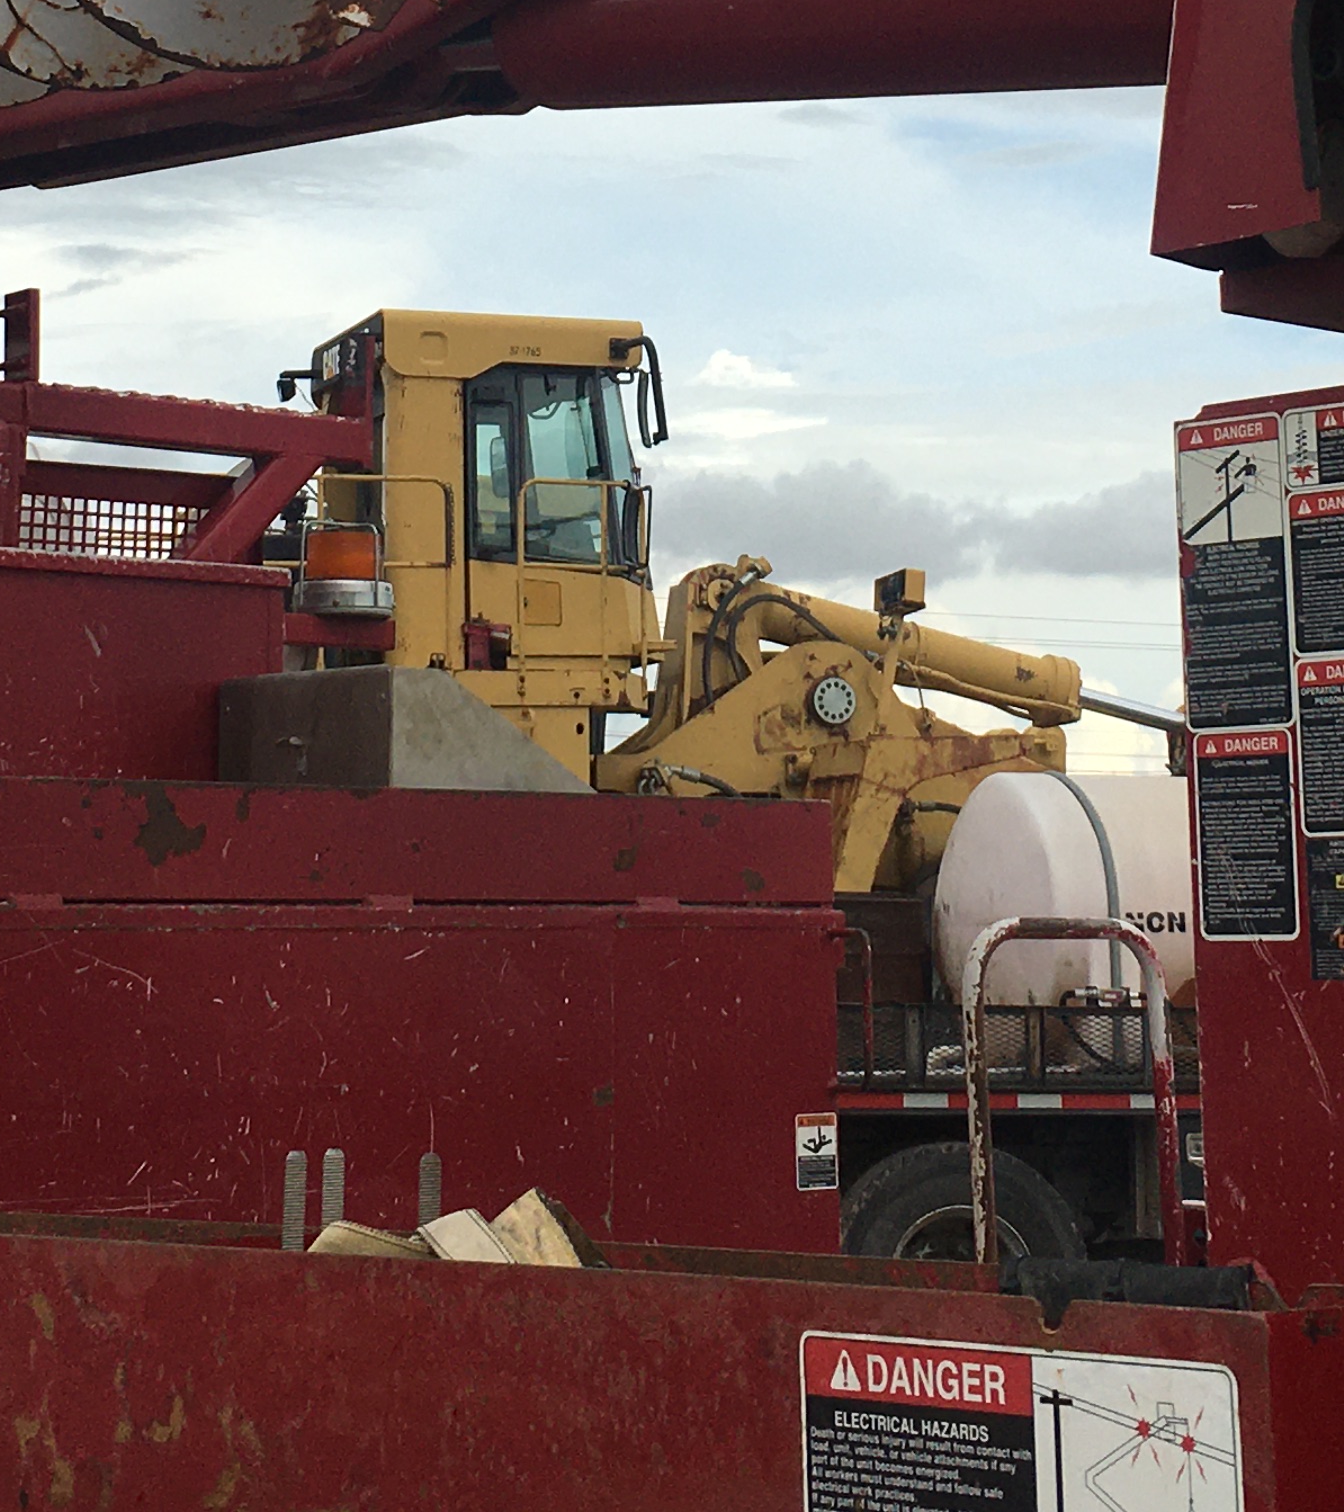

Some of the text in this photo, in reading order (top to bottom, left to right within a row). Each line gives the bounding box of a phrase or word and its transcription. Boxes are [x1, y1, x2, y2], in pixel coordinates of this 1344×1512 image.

[1213, 422, 1264, 441] DANGER
[1301, 685, 1341, 696] OPERATION
[1224, 737, 1279, 753] DANGER
[867, 1354, 1006, 1405] DANGER
[834, 1410, 990, 1443] ELECTRICAL HAZARDS
[810, 1426, 1032, 1460] Death or serious injury will result from contact with
[811, 1454, 828, 1465] part
[829, 1455, 839, 1465] of
[840, 1456, 854, 1468] the
[856, 1460, 873, 1470] unit
[874, 1460, 914, 1476] becomes
[889, 1450, 898, 1460] or
[901, 1451, 932, 1464] vehicle
[934, 1454, 988, 1470] attachments
[990, 1459, 998, 1471] if
[999, 1462, 1016, 1475] any
[812, 1467, 1004, 1500] All workers must understand and follow safe
[812, 1479, 850, 1494] electrical
[851, 1486, 873, 1496] work
[820, 1495, 835, 1507] any
[837, 1497, 854, 1508] part
[867, 1498, 881, 1510] the
